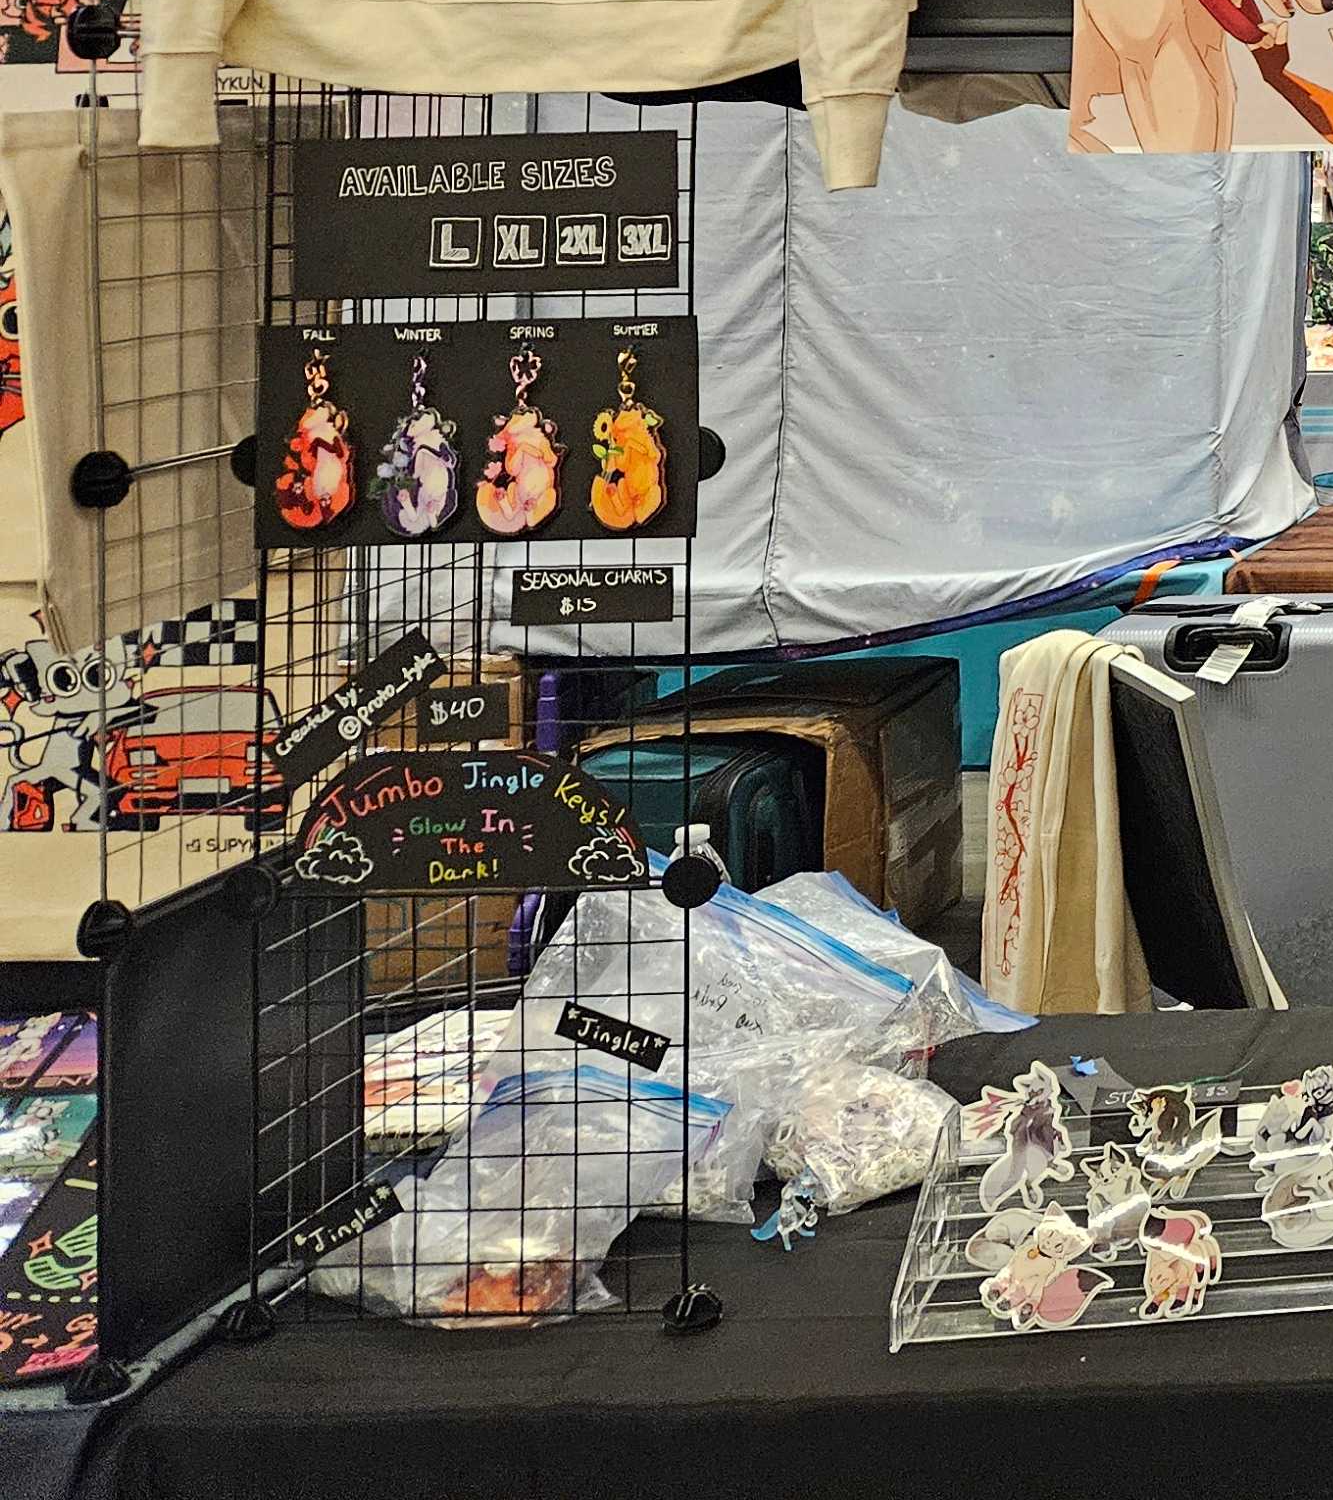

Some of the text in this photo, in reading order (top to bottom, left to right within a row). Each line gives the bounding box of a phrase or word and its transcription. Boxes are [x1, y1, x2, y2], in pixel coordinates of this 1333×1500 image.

[339, 155, 618, 198] AVAILABLE SIZES
[441, 222, 668, 261] L XL 2XL 3XL
[302, 328, 336, 341] FALL
[394, 327, 442, 342] WINTER
[509, 325, 555, 340] SPRING
[613, 322, 659, 337] SUMMER
[520, 569, 668, 592] SEASONAL CHARMS
[560, 596, 597, 616] $15
[275, 681, 364, 757] created by:
[430, 697, 485, 726] $40
[320, 767, 443, 828] Jumbo
[461, 761, 545, 796] Jingle
[408, 808, 515, 837] Glow In
[440, 838, 484, 855] The
[429, 859, 500, 884] Dark!
